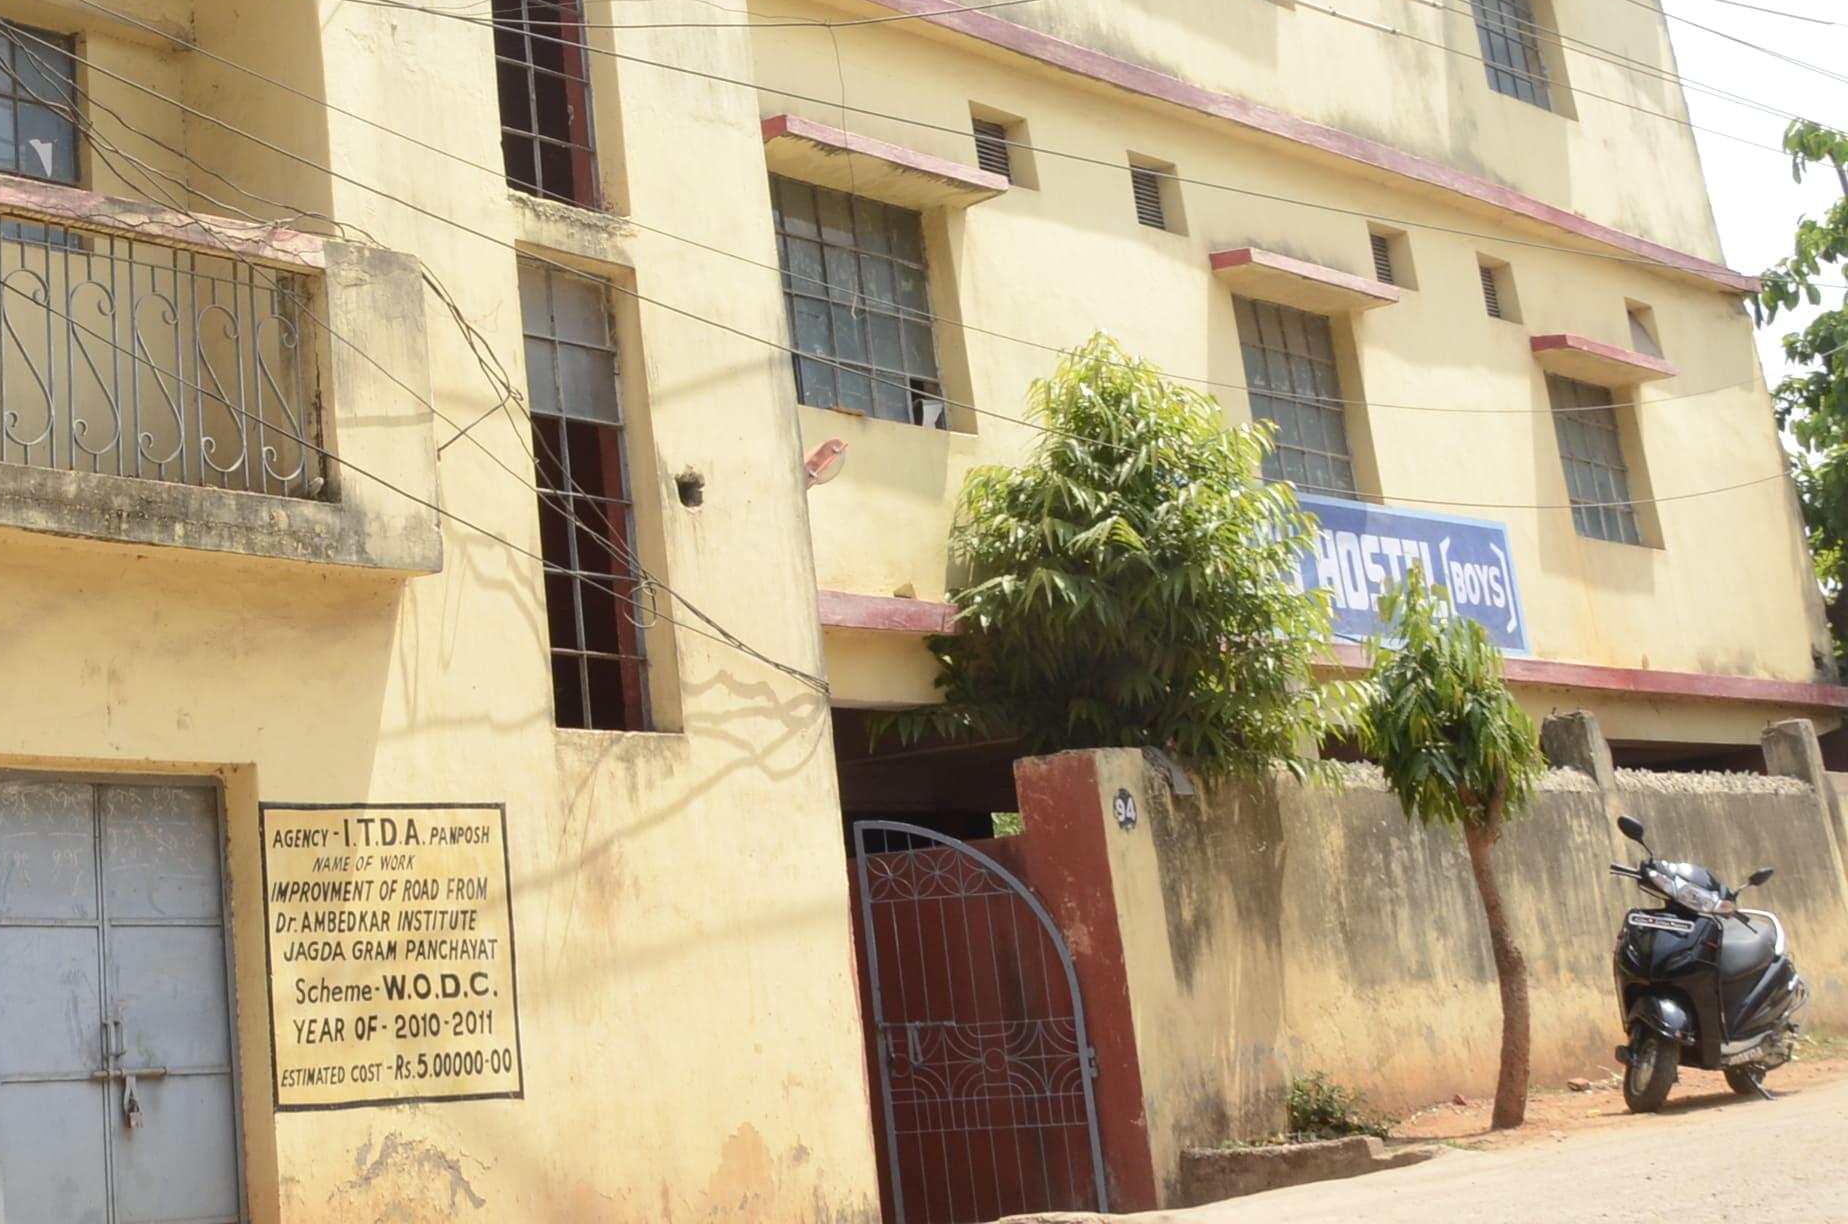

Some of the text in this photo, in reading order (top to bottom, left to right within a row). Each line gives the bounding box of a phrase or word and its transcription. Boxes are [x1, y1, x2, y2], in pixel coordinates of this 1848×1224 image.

[1114, 798, 1136, 822] 94
[344, 818, 426, 848] I.T.D.A.
[429, 825, 490, 846] PANPOSH
[312, 854, 415, 872] NAME OF WORK
[271, 877, 488, 904] IMPROVMENT OF ROAD FROM
[397, 909, 477, 932] INSTITUTE
[283, 938, 498, 962] JAGDA GRAM PANCHAYAT
[293, 1017, 345, 1044] YEAR
[281, 1065, 345, 1088] ESTIMATED
